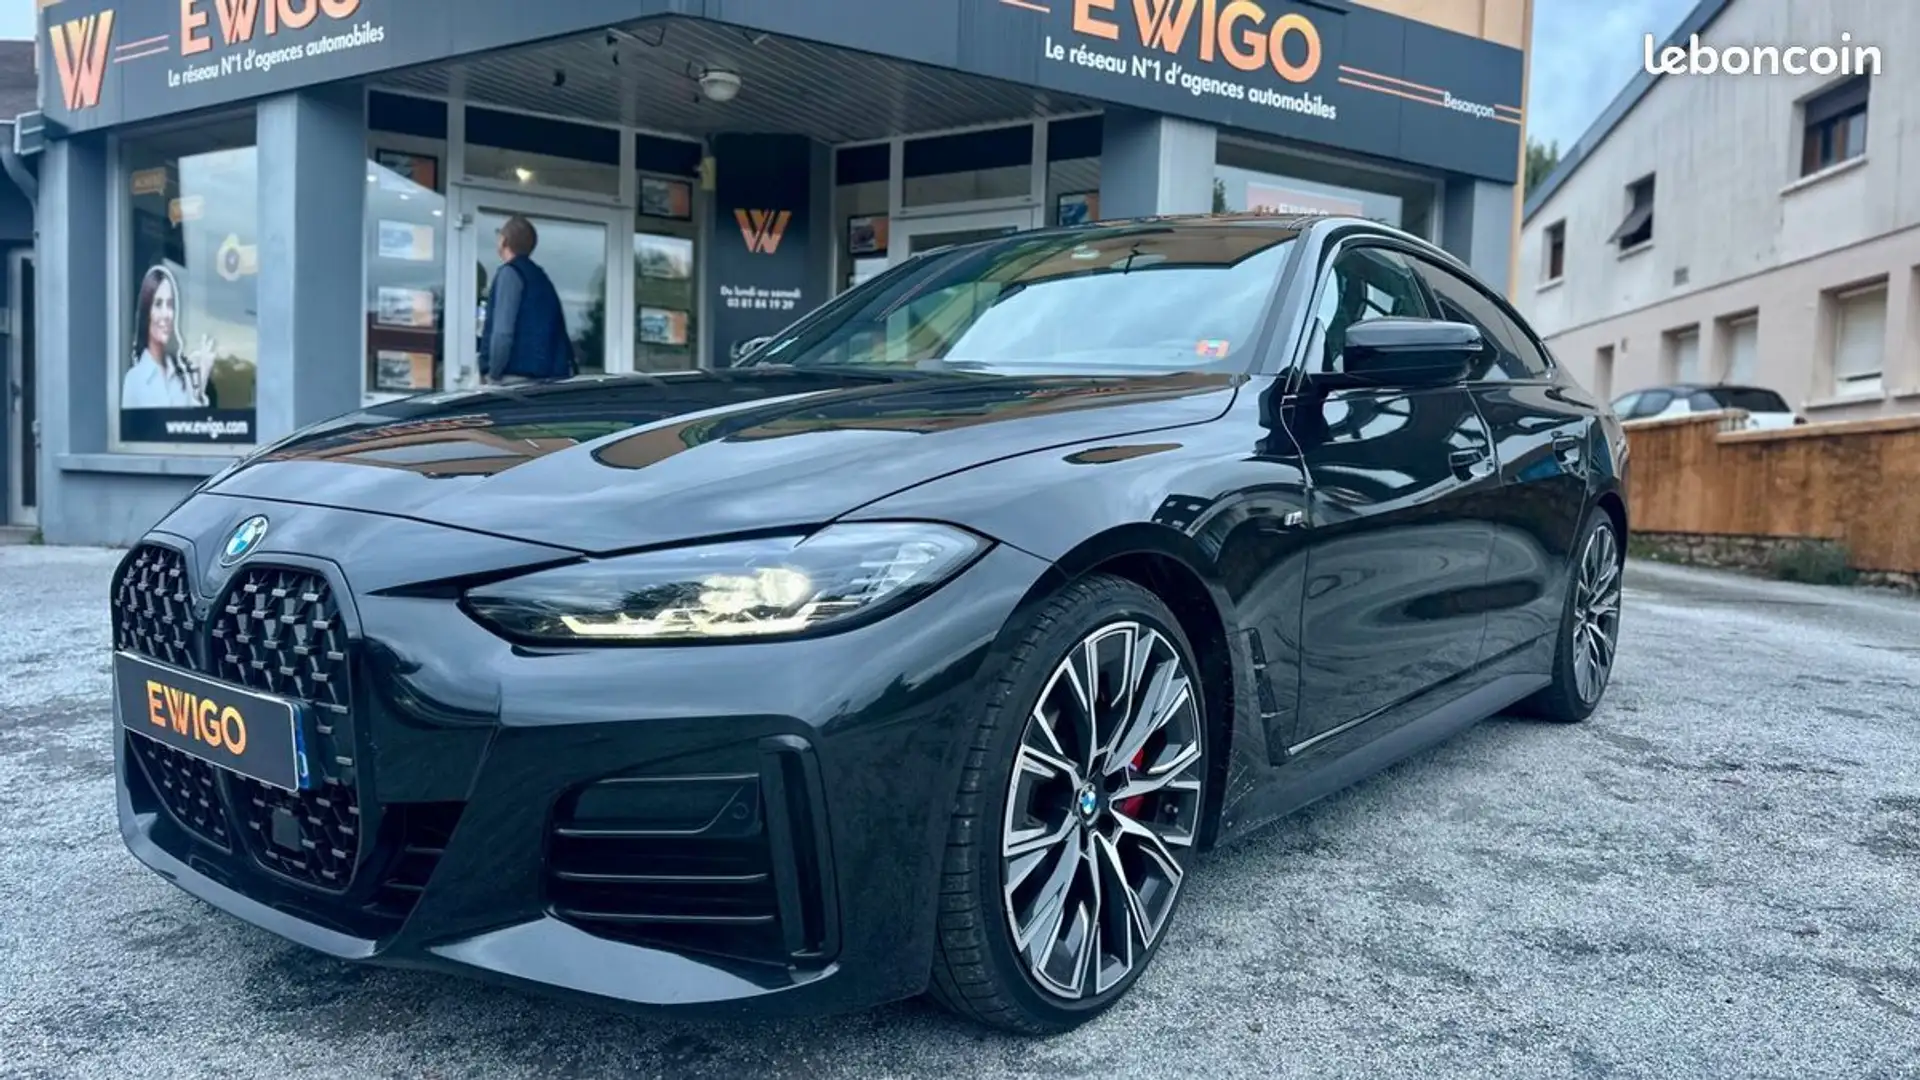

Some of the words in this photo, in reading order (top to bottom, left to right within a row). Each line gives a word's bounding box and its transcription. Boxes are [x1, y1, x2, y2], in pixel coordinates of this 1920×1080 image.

[168, 69, 181, 88] Le
[182, 62, 219, 84] réseau
[305, 21, 385, 57] automobiles
[1073, 0, 1322, 83] EWIGO
[1045, 35, 1065, 61] Le
[1069, 43, 1127, 74] réseau
[1164, 61, 1245, 100] d'agences
[1248, 87, 1337, 120] automobiles
[1444, 91, 1496, 119] Besançon
[166, 416, 248, 439] www.ewigo.com
[147, 680, 247, 756] EWIGO
